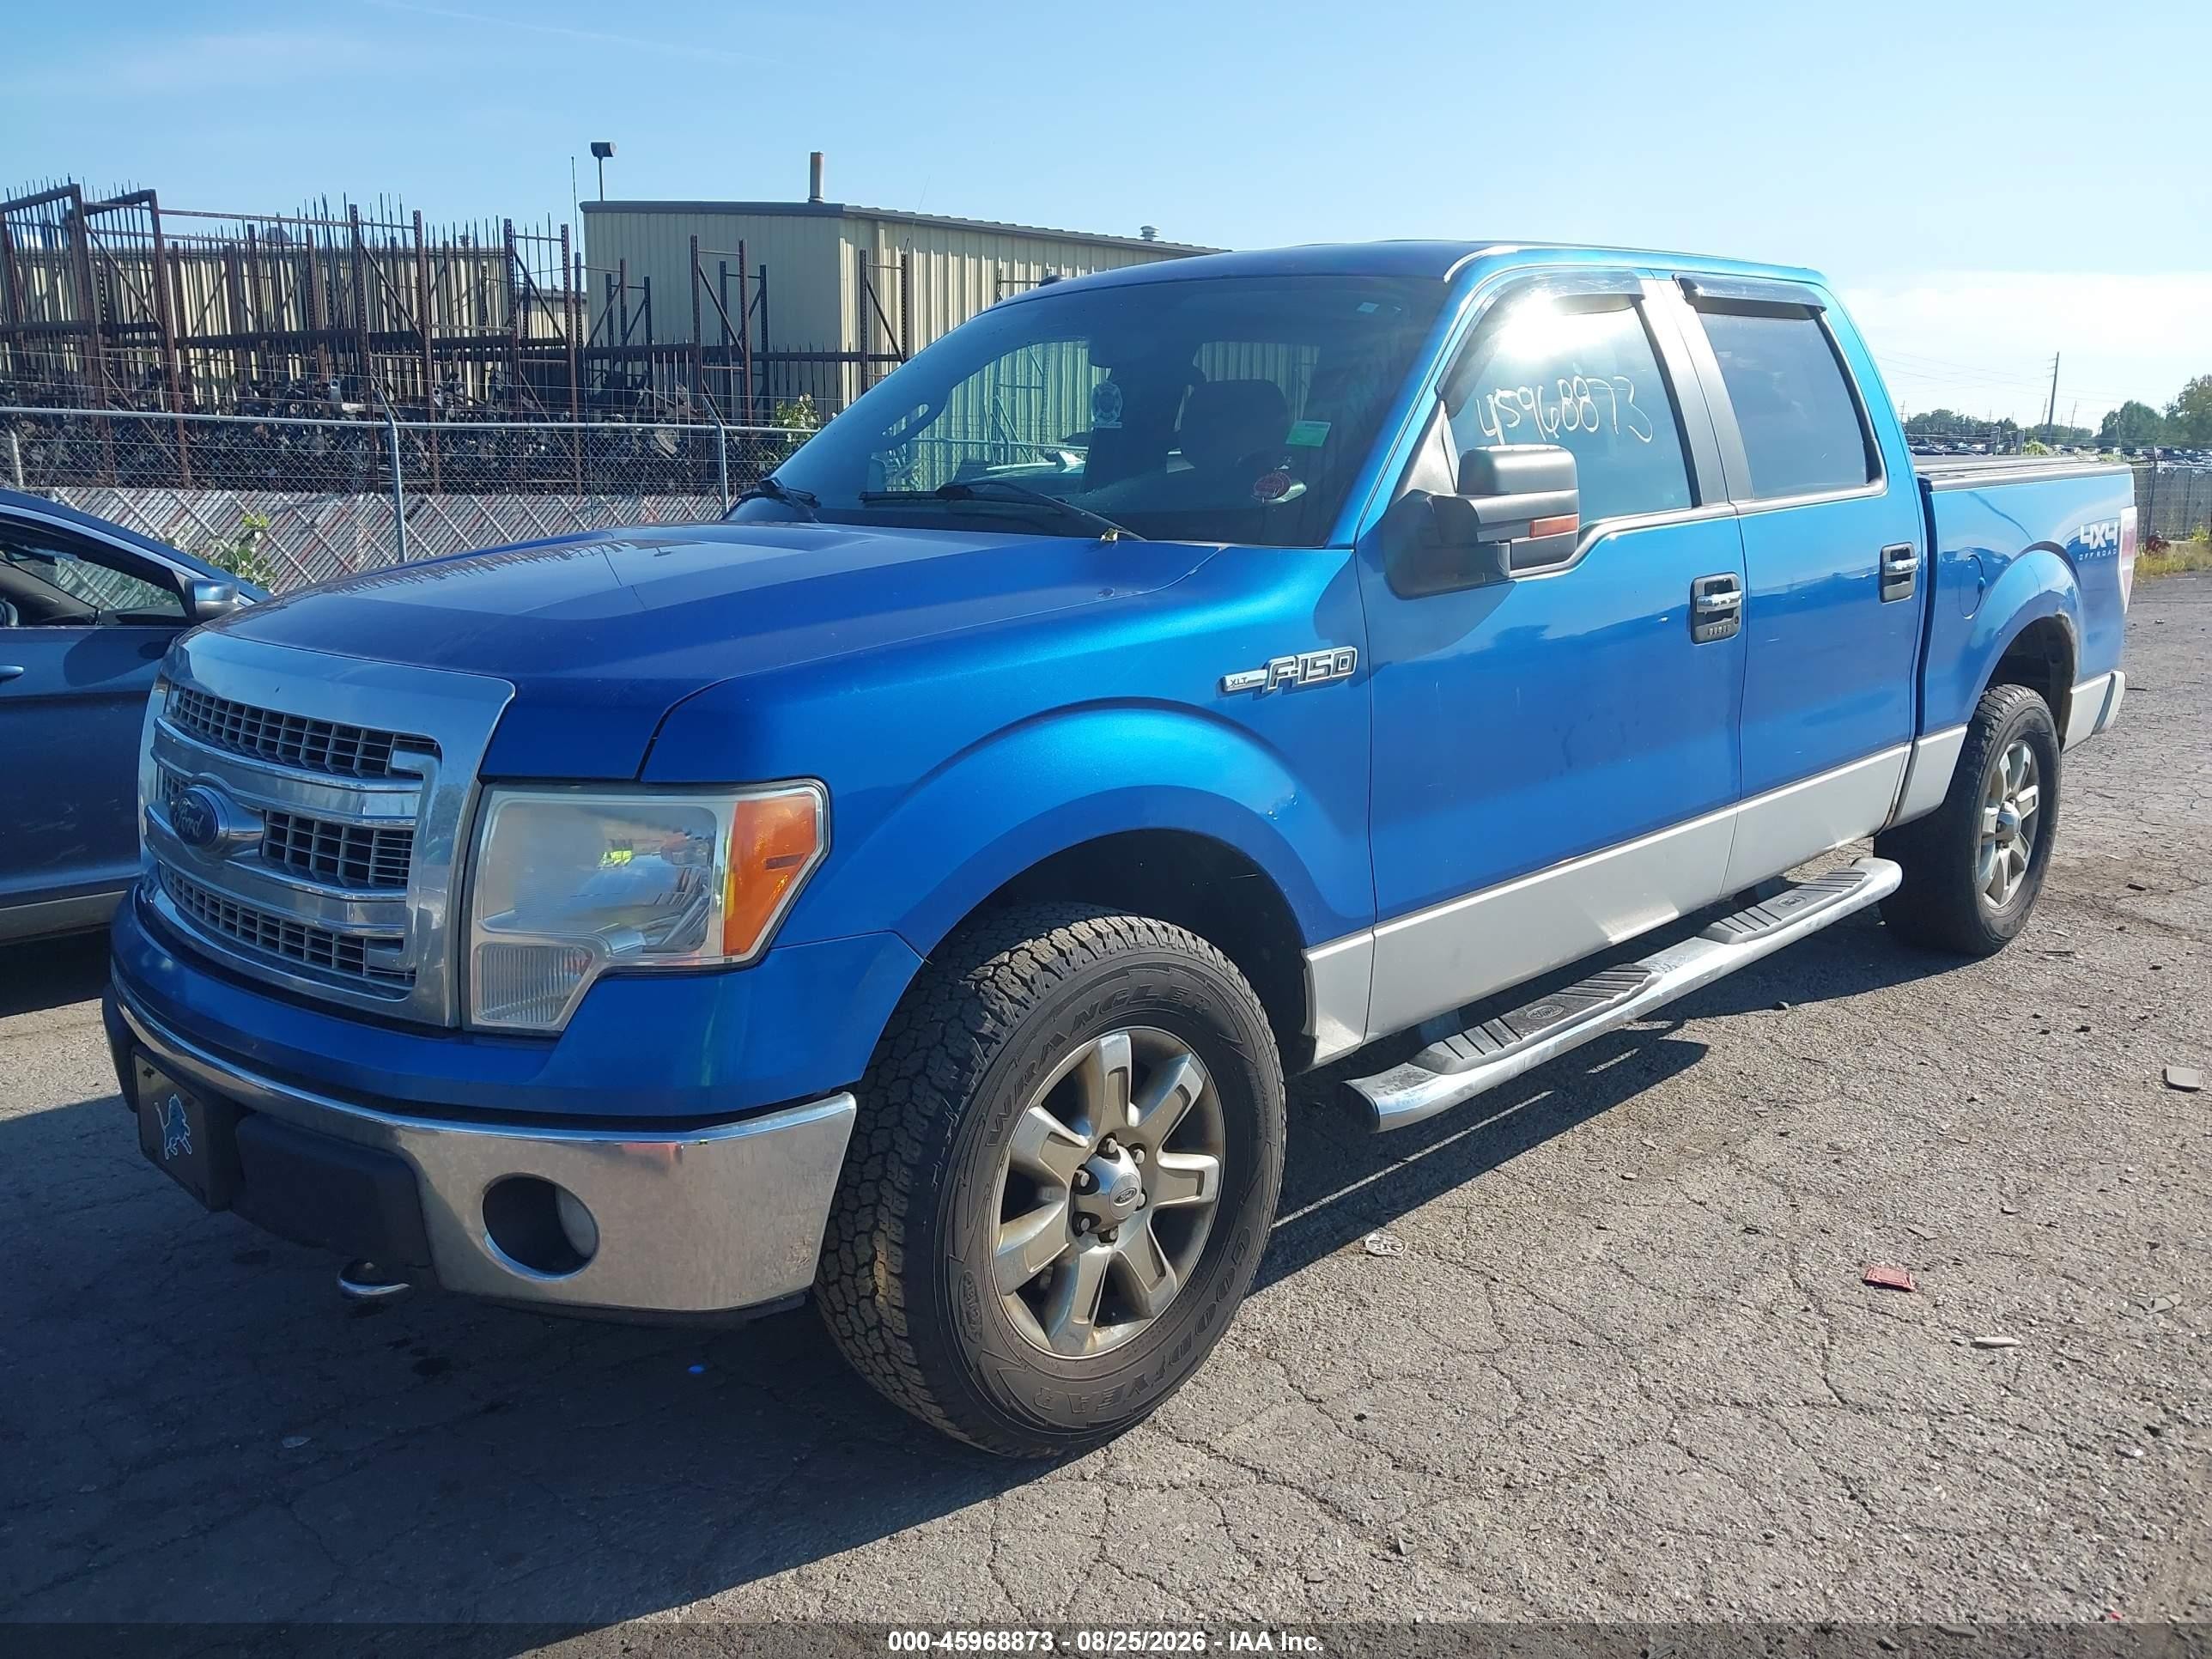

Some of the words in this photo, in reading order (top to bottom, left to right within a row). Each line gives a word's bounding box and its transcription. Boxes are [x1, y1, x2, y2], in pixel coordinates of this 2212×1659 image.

[1476, 375, 1653, 446] 45968873
[2079, 551, 2094, 561] OFF
[2096, 548, 2118, 557] ROAD
[1230, 677, 1248, 687] XLT
[175, 797, 205, 838] Ford
[986, 983, 1212, 1147] WRANGLER
[1033, 1227, 1251, 1415] GOODYEAR
